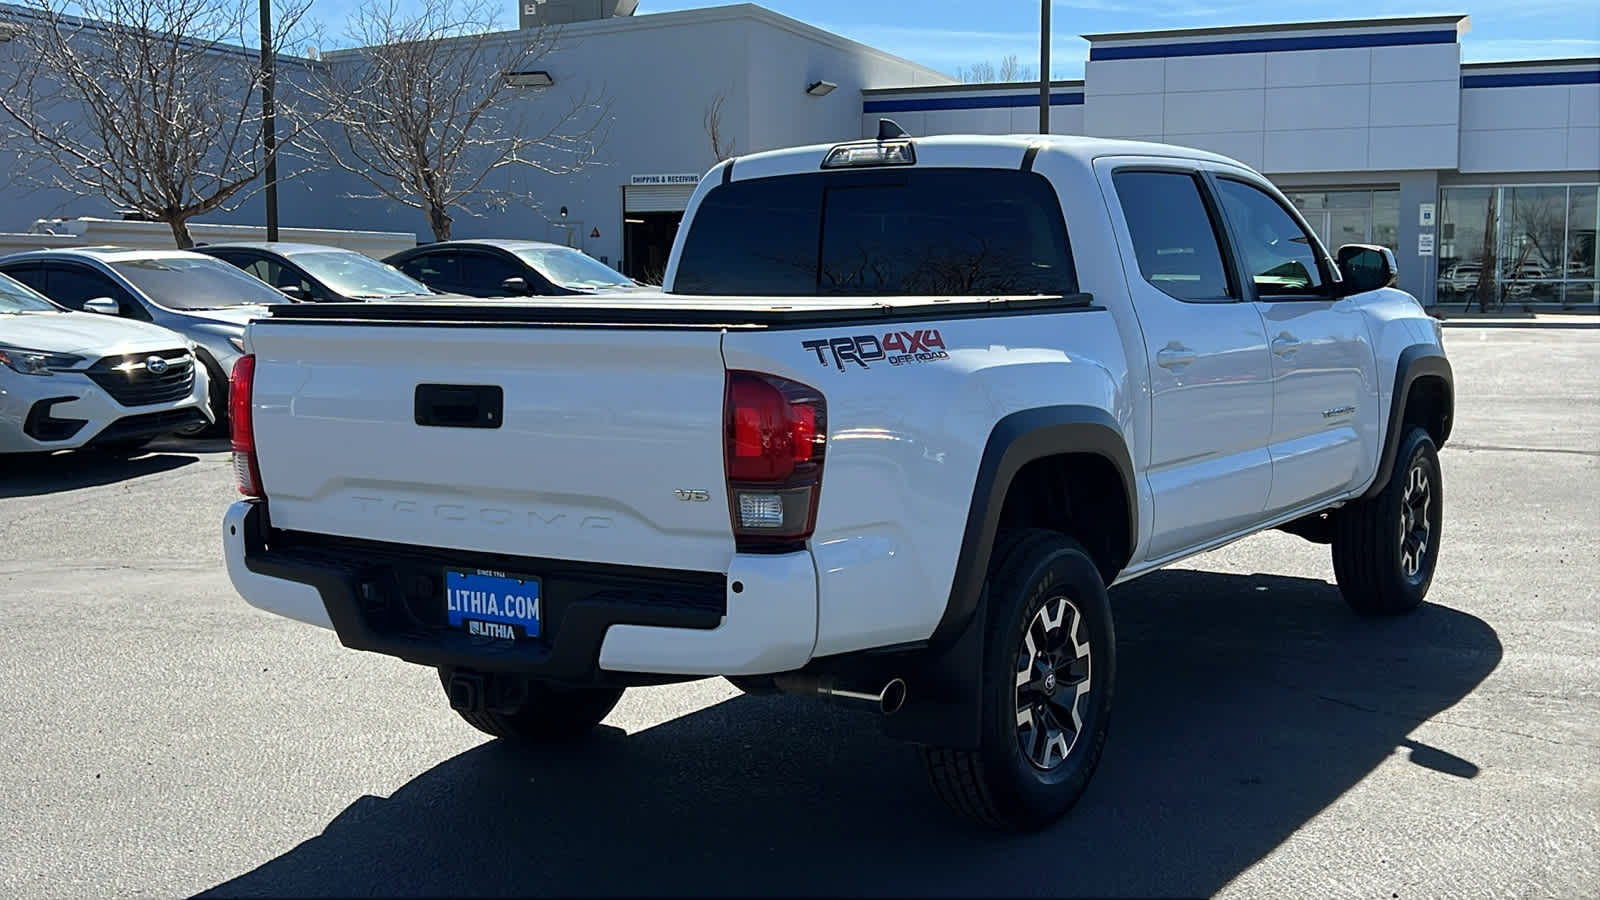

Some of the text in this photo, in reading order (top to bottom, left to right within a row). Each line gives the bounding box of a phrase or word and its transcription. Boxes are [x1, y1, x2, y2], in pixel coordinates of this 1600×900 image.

[632, 175, 660, 183] SHIPPING
[888, 350, 950, 366] OFF ROAD
[673, 488, 710, 502] V6
[350, 495, 616, 530] TACOMA
[447, 588, 540, 621] LITHIA.COM
[480, 621, 515, 640] LITHIA
